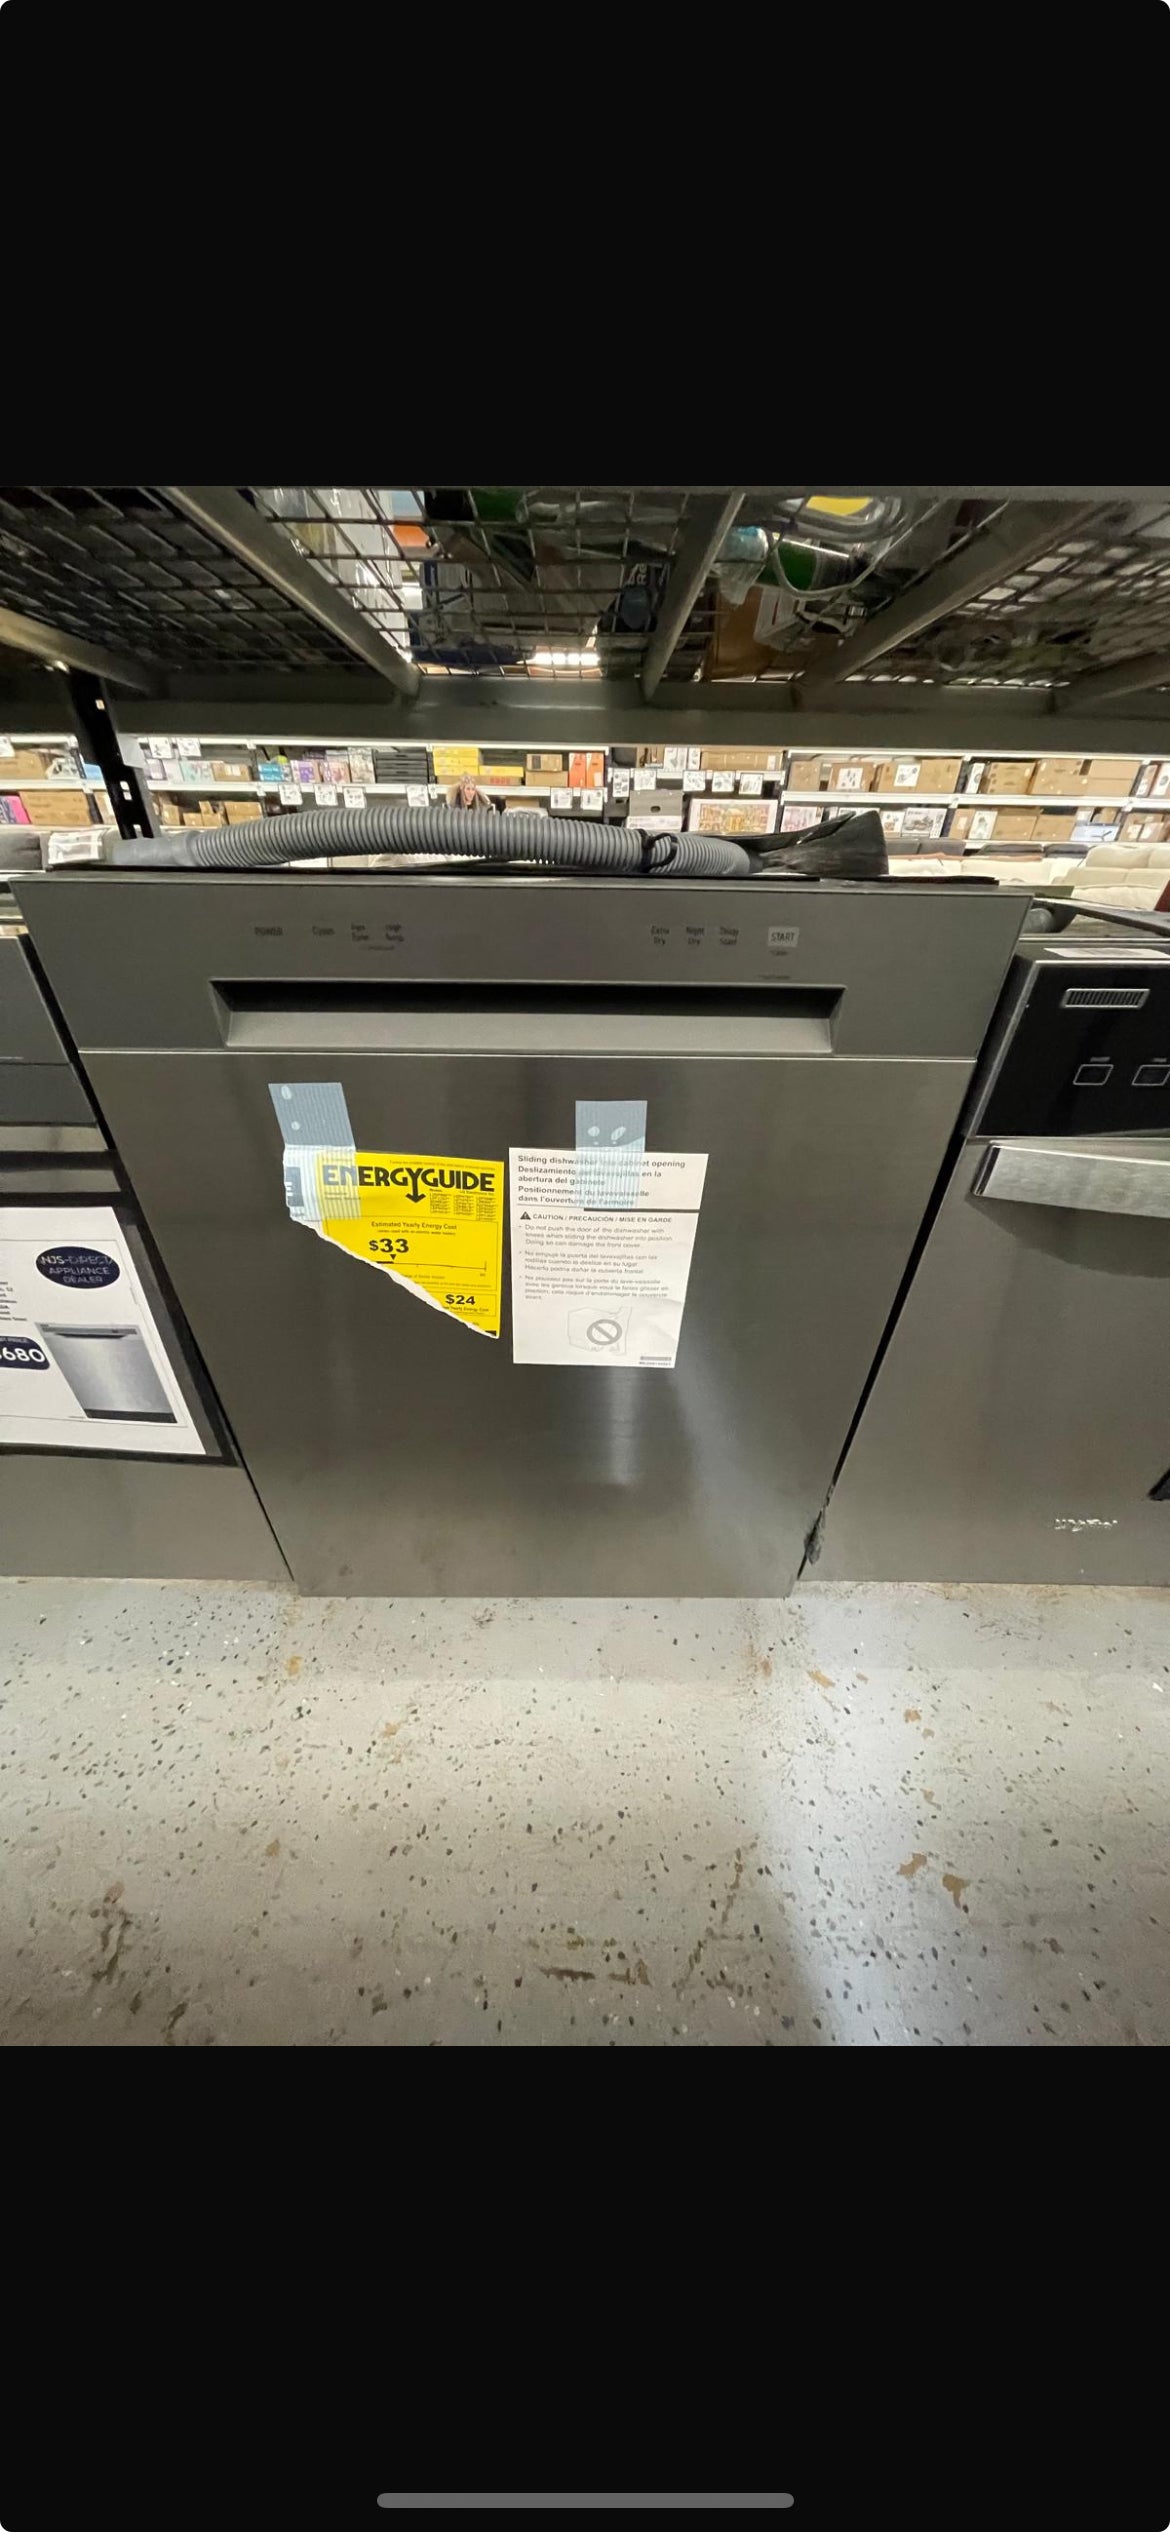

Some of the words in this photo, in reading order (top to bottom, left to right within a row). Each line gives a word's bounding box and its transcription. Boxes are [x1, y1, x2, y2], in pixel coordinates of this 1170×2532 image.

[771, 932, 795, 942] START
[518, 1155, 547, 1164] Sliding
[549, 1156, 598, 1166] dishwasher
[518, 1166, 576, 1175] Deslizamiento
[323, 1165, 495, 1200] ENERGYGUIDE
[518, 1175, 552, 1183] abertura
[570, 1178, 605, 1186] gabinete
[518, 1186, 582, 1195] Positionnement
[540, 1196, 584, 1204] l'ouverture
[369, 1238, 409, 1253] $33
[49, 1266, 110, 1275] APPLIANCE
[62, 1276, 103, 1284] DEALER
[446, 1294, 476, 1305] $24
[0, 1347, 46, 1362] 680
